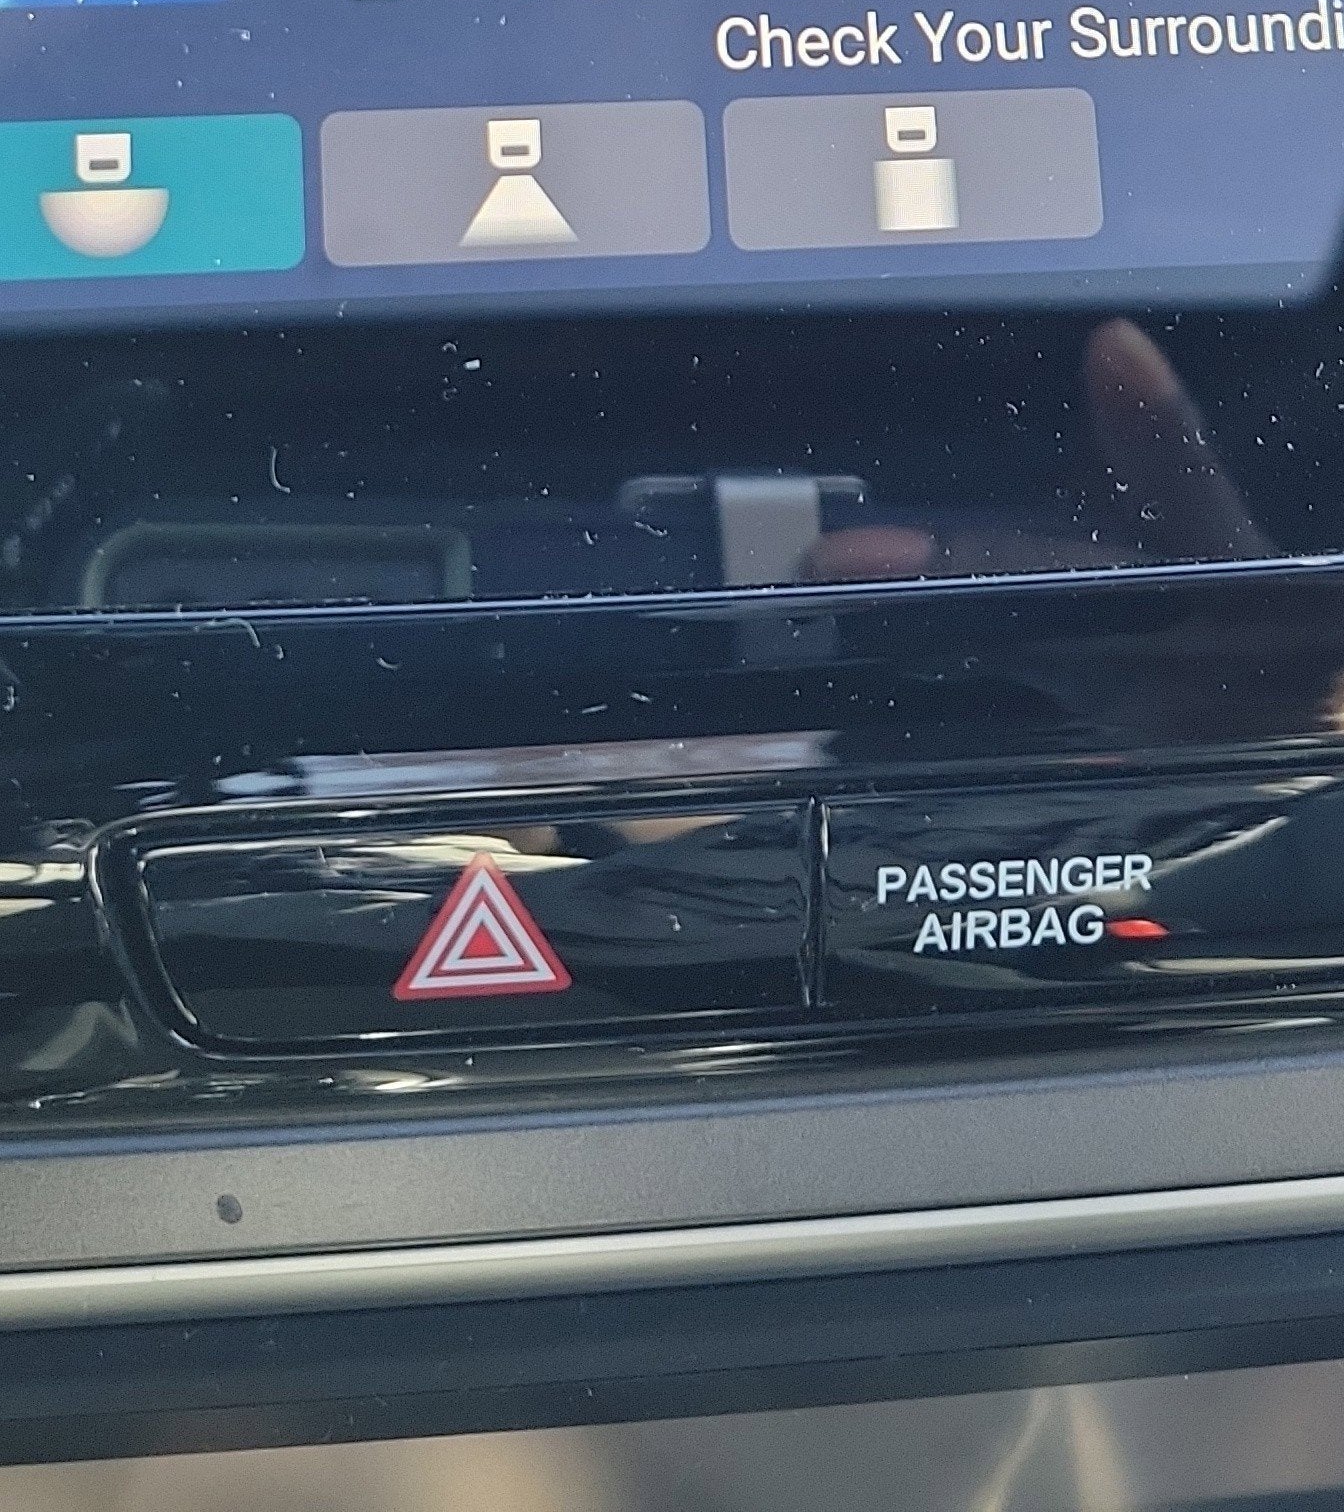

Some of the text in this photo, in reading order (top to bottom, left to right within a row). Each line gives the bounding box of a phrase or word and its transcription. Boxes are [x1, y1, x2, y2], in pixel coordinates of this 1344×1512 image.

[715, 11, 902, 71] Check
[912, 9, 1052, 65] Your
[876, 854, 1154, 904] PASSENGER
[912, 904, 1106, 954] AIRBAG
